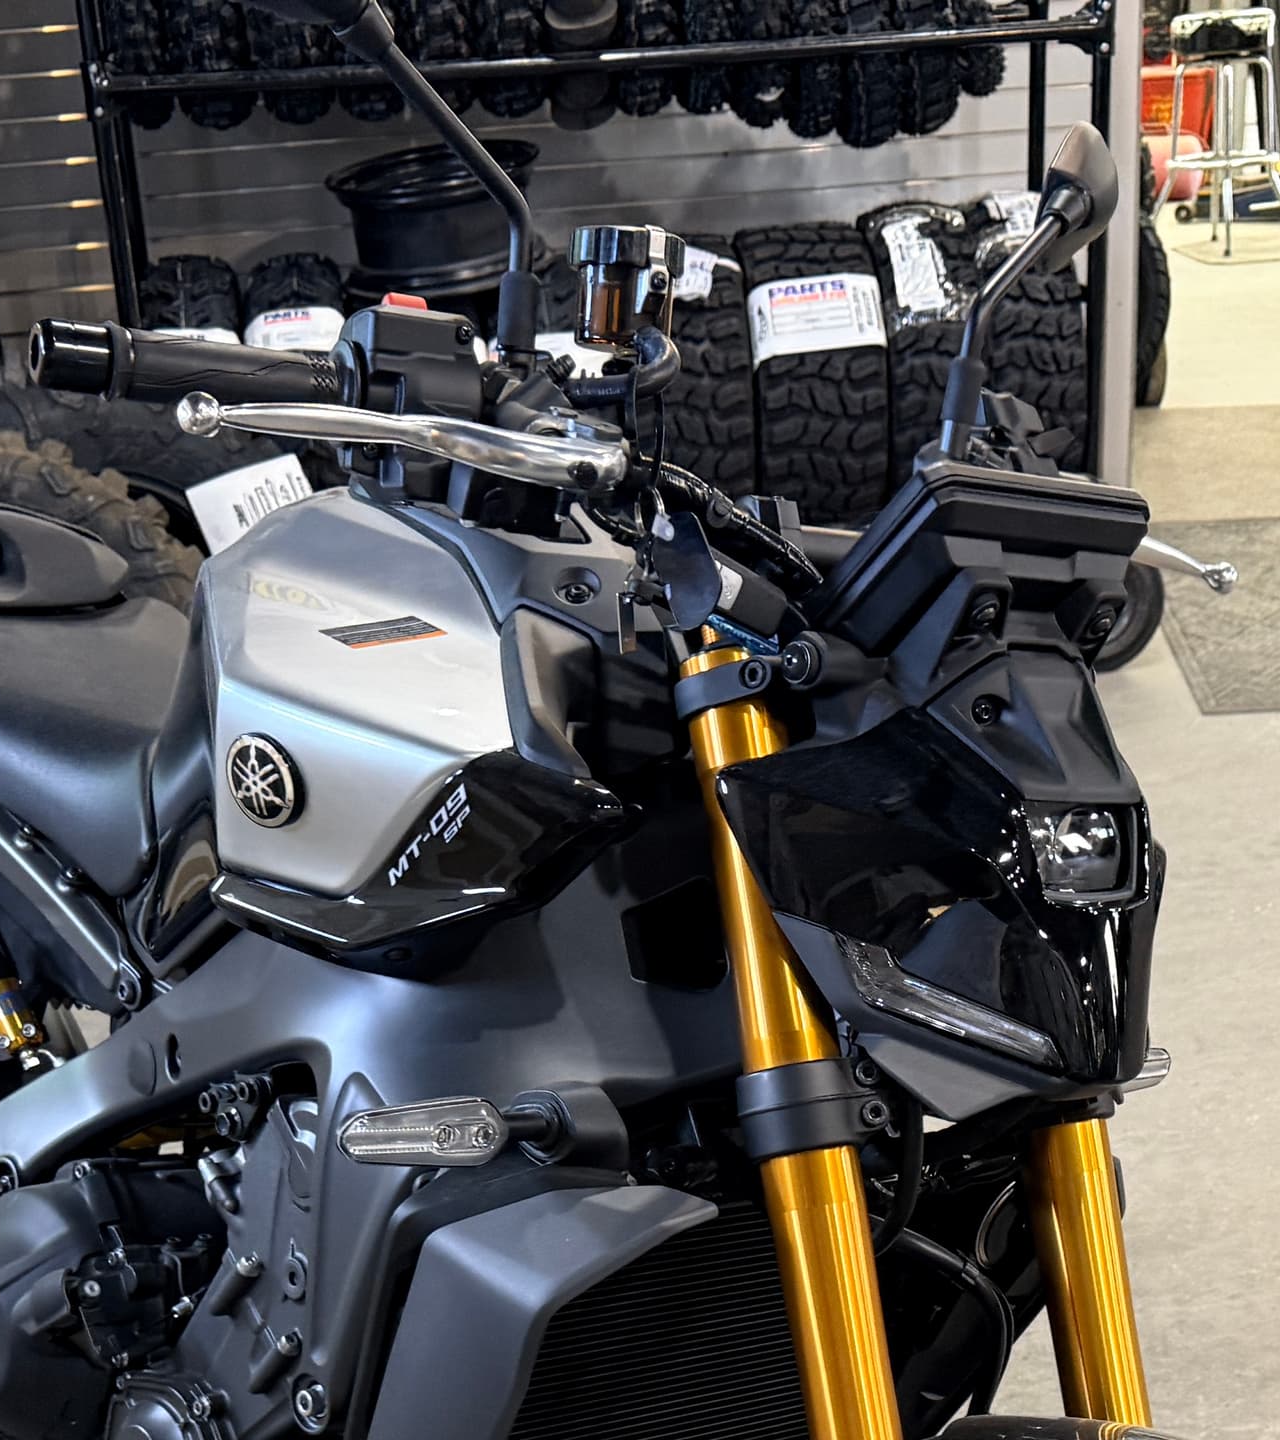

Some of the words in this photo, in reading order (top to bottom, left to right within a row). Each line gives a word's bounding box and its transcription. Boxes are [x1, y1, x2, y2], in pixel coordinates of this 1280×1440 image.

[768, 279, 844, 298] PARTS
[388, 783, 467, 887] MT-09
[443, 804, 471, 843] SP
